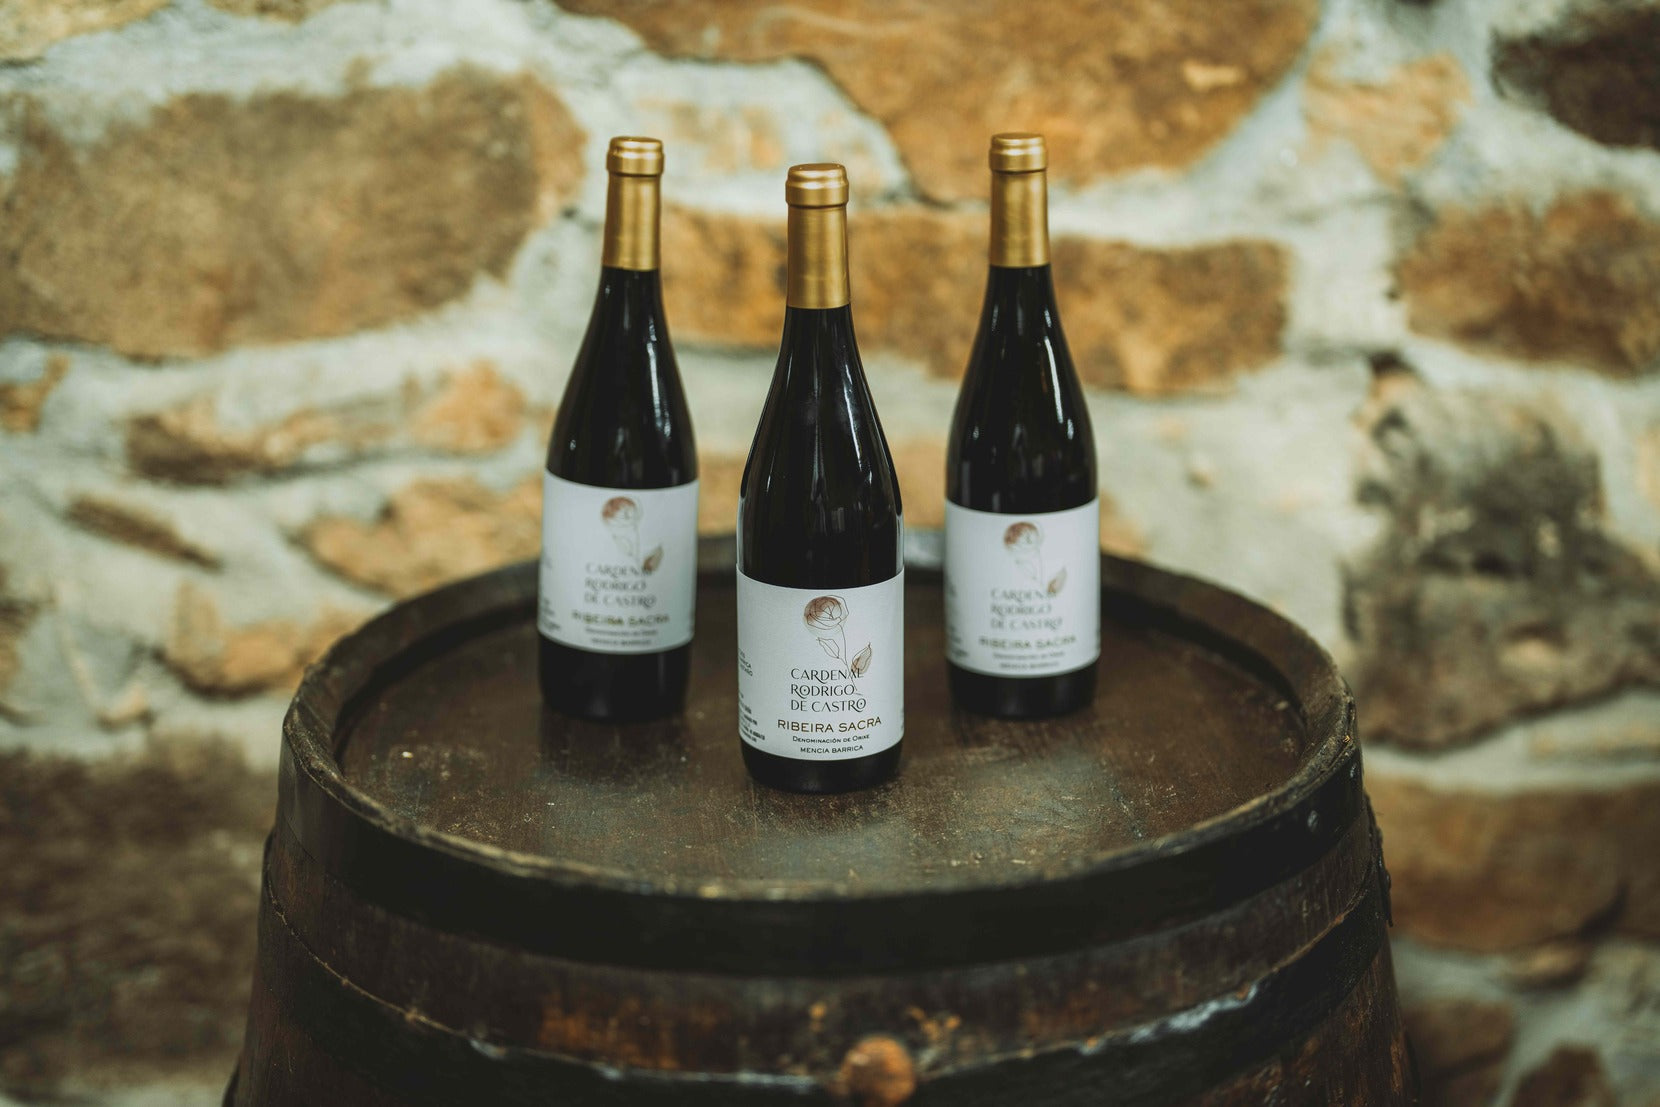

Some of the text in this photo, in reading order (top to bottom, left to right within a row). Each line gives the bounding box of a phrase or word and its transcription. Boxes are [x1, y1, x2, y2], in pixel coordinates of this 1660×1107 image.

[791, 668, 864, 684] CARDENAL
[791, 684, 855, 699] RODRIGO
[791, 698, 867, 713] DE CASTRO
[777, 716, 882, 733] RIBEIRA SACRA
[831, 745, 864, 754] BARRICA
